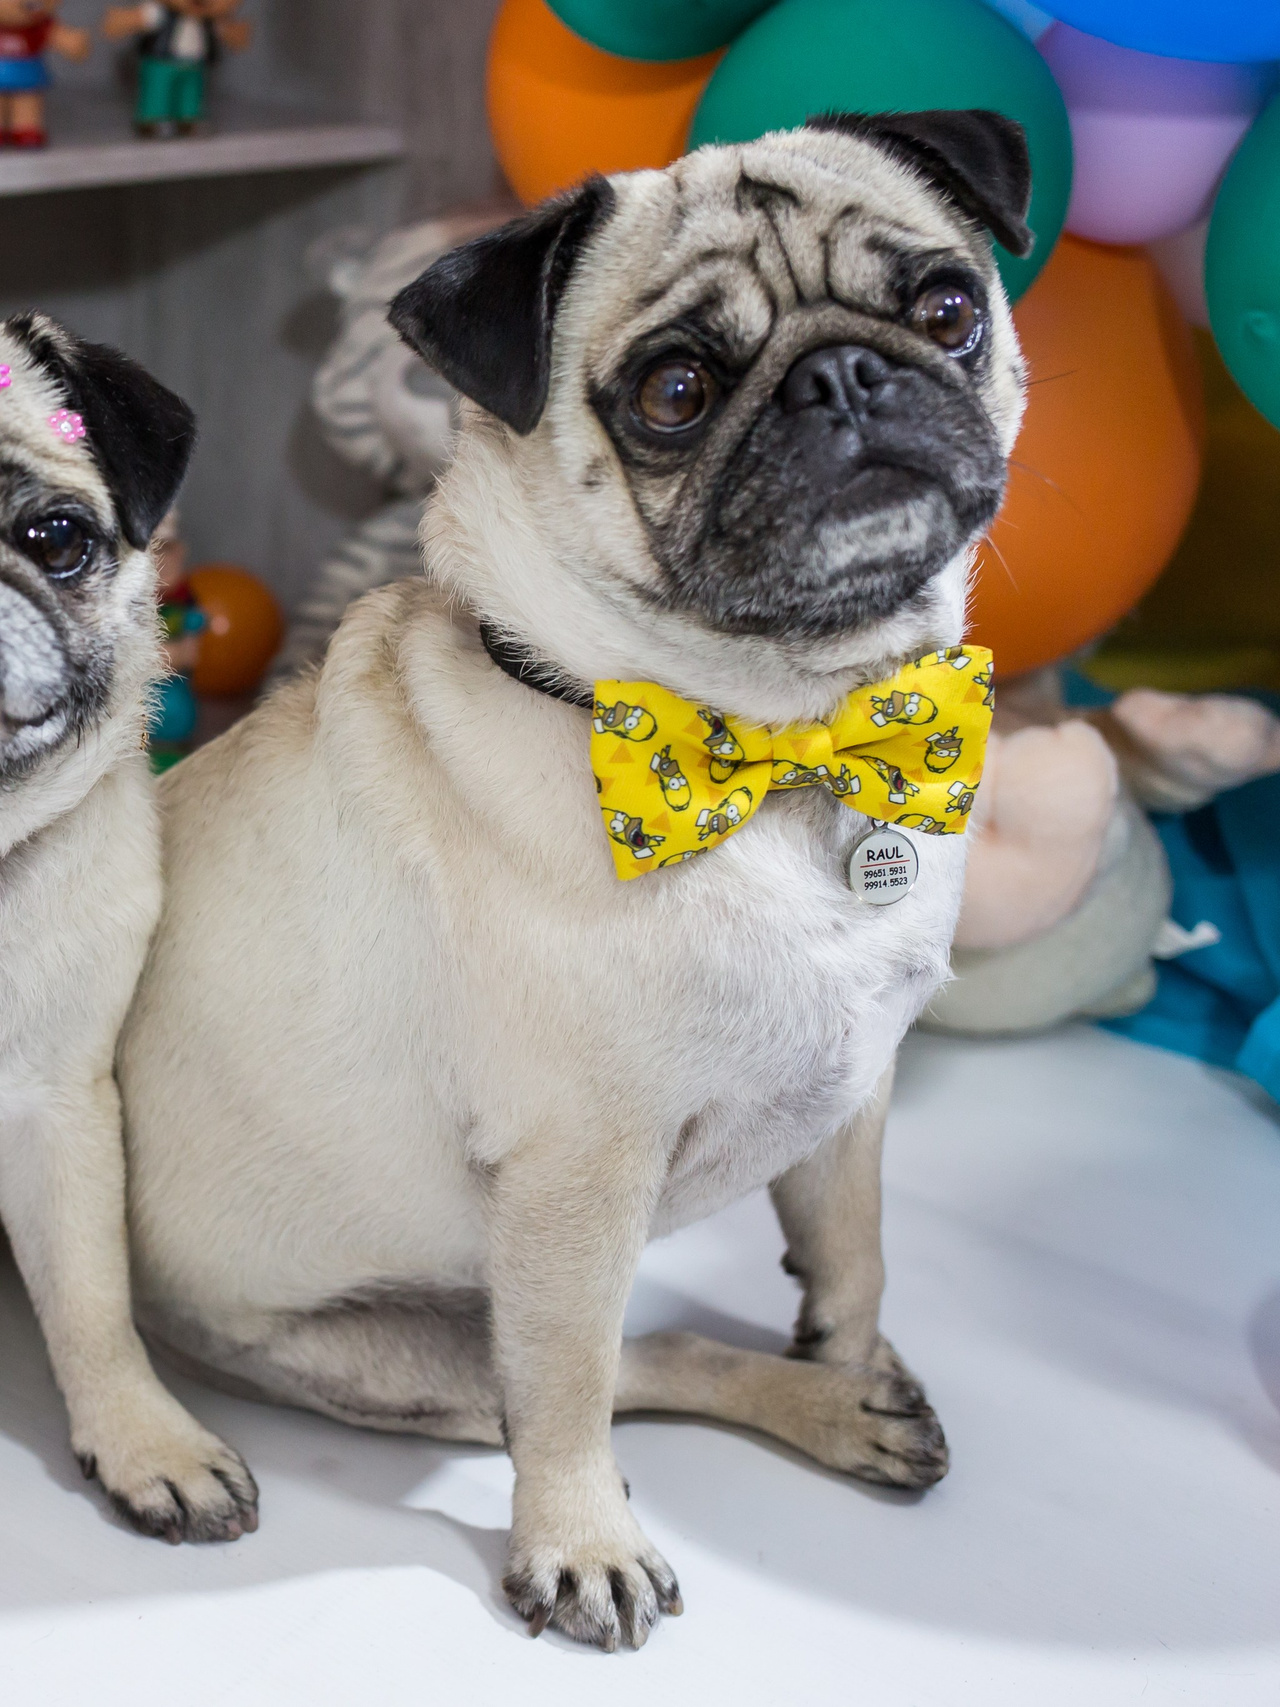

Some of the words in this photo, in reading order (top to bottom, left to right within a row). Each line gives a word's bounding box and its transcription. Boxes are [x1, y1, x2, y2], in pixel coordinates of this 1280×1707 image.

[866, 845, 904, 862] RAUL
[863, 866, 907, 879] 99651.5931
[864, 877, 908, 891] 99914.5523
